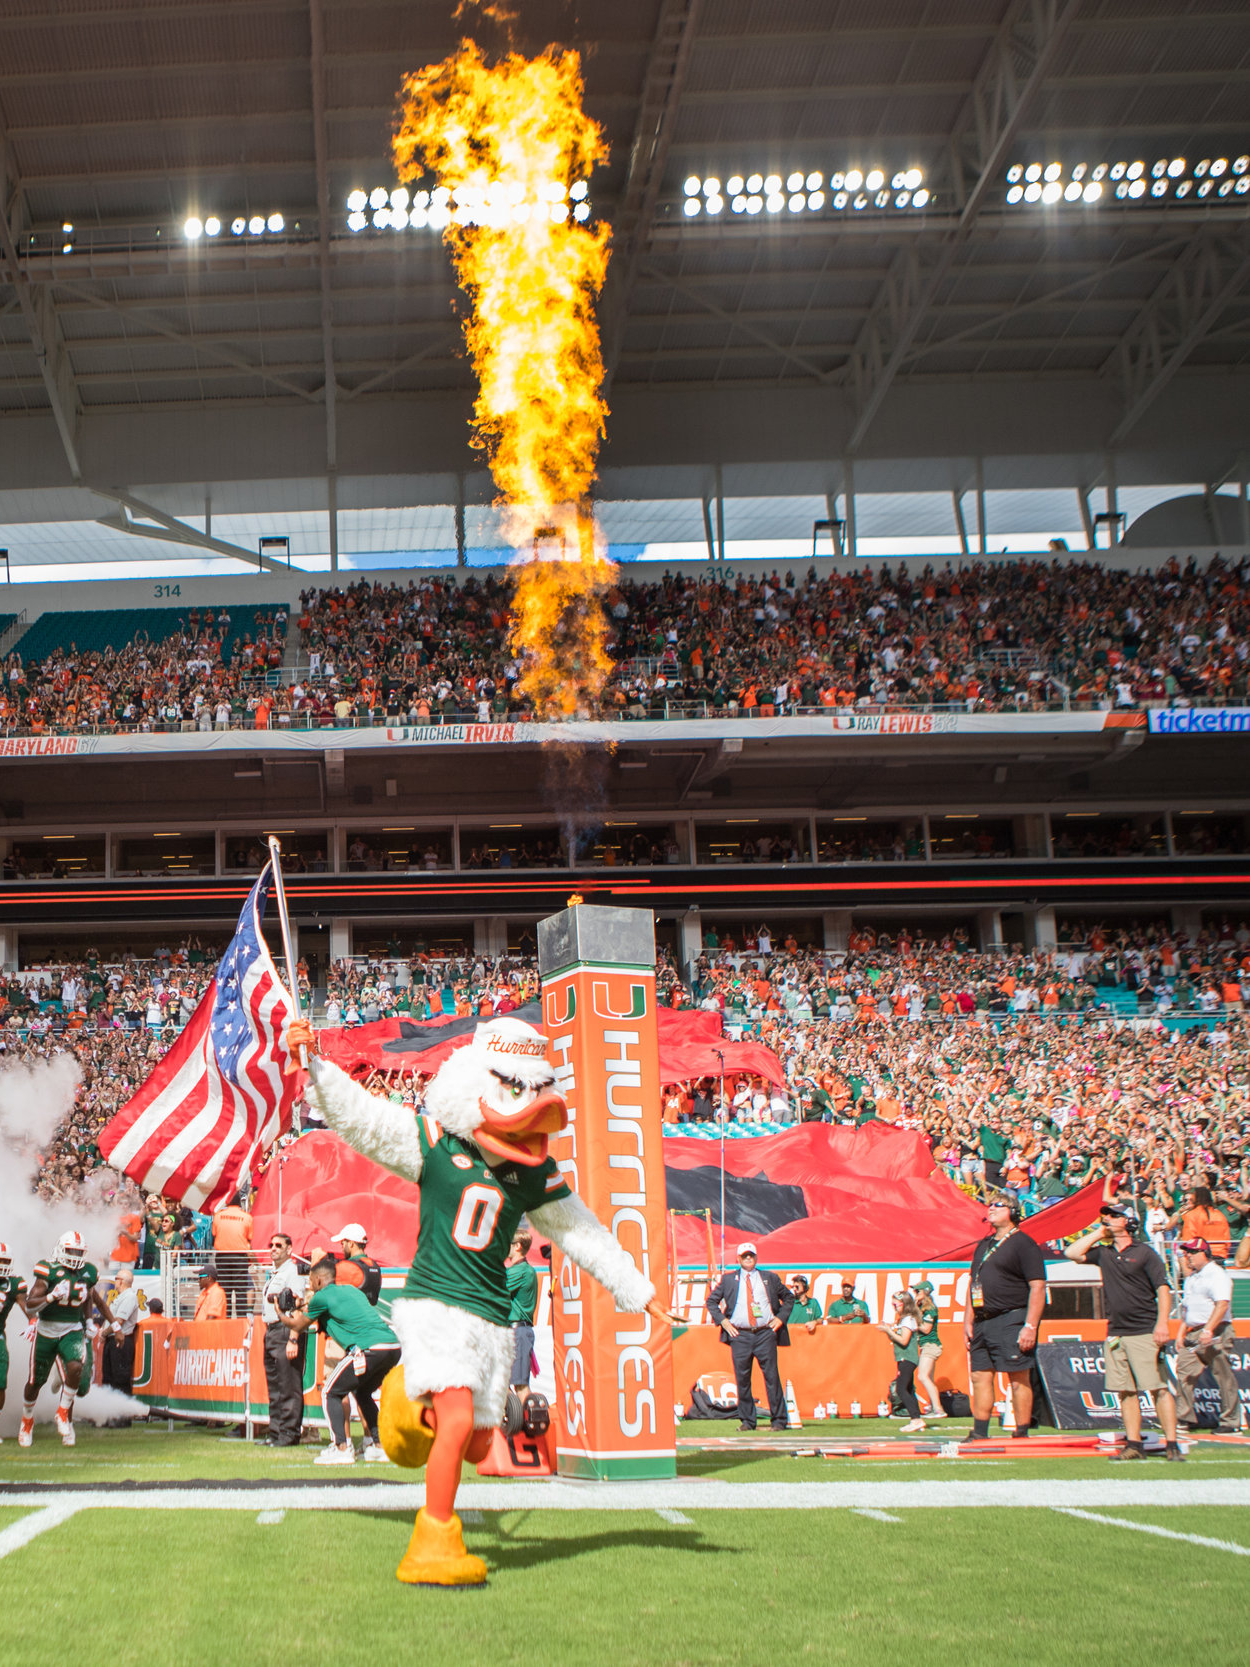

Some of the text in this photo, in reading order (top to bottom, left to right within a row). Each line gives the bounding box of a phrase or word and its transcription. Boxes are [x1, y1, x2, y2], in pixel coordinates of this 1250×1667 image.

[706, 566, 734, 581] 316
[153, 584, 181, 598] 314
[411, 725, 465, 742] MICHAEL
[464, 723, 516, 743] IRVIN
[857, 717, 880, 731] RAY
[879, 714, 933, 734] LEWIS
[452, 1182, 504, 1252] 0
[174, 1348, 246, 1388] HURRICANES
